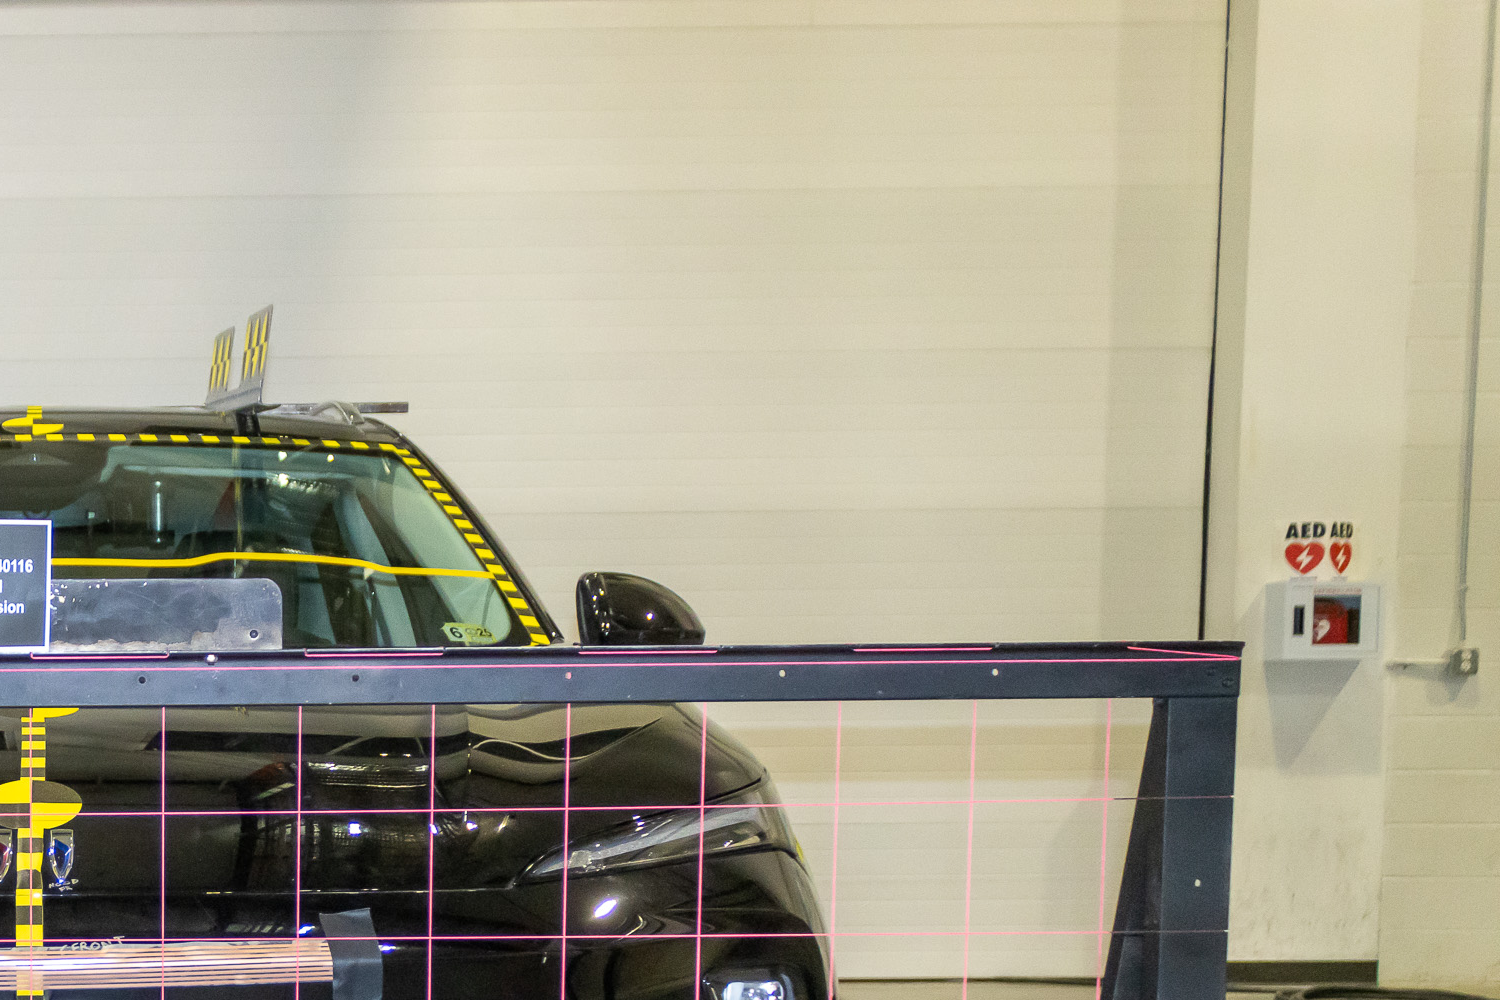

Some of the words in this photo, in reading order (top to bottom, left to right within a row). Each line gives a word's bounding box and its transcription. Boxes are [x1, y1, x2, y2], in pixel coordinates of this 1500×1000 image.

[1285, 522, 1326, 539] AED
[1330, 521, 1353, 539] AED
[450, 627, 463, 639] 6
